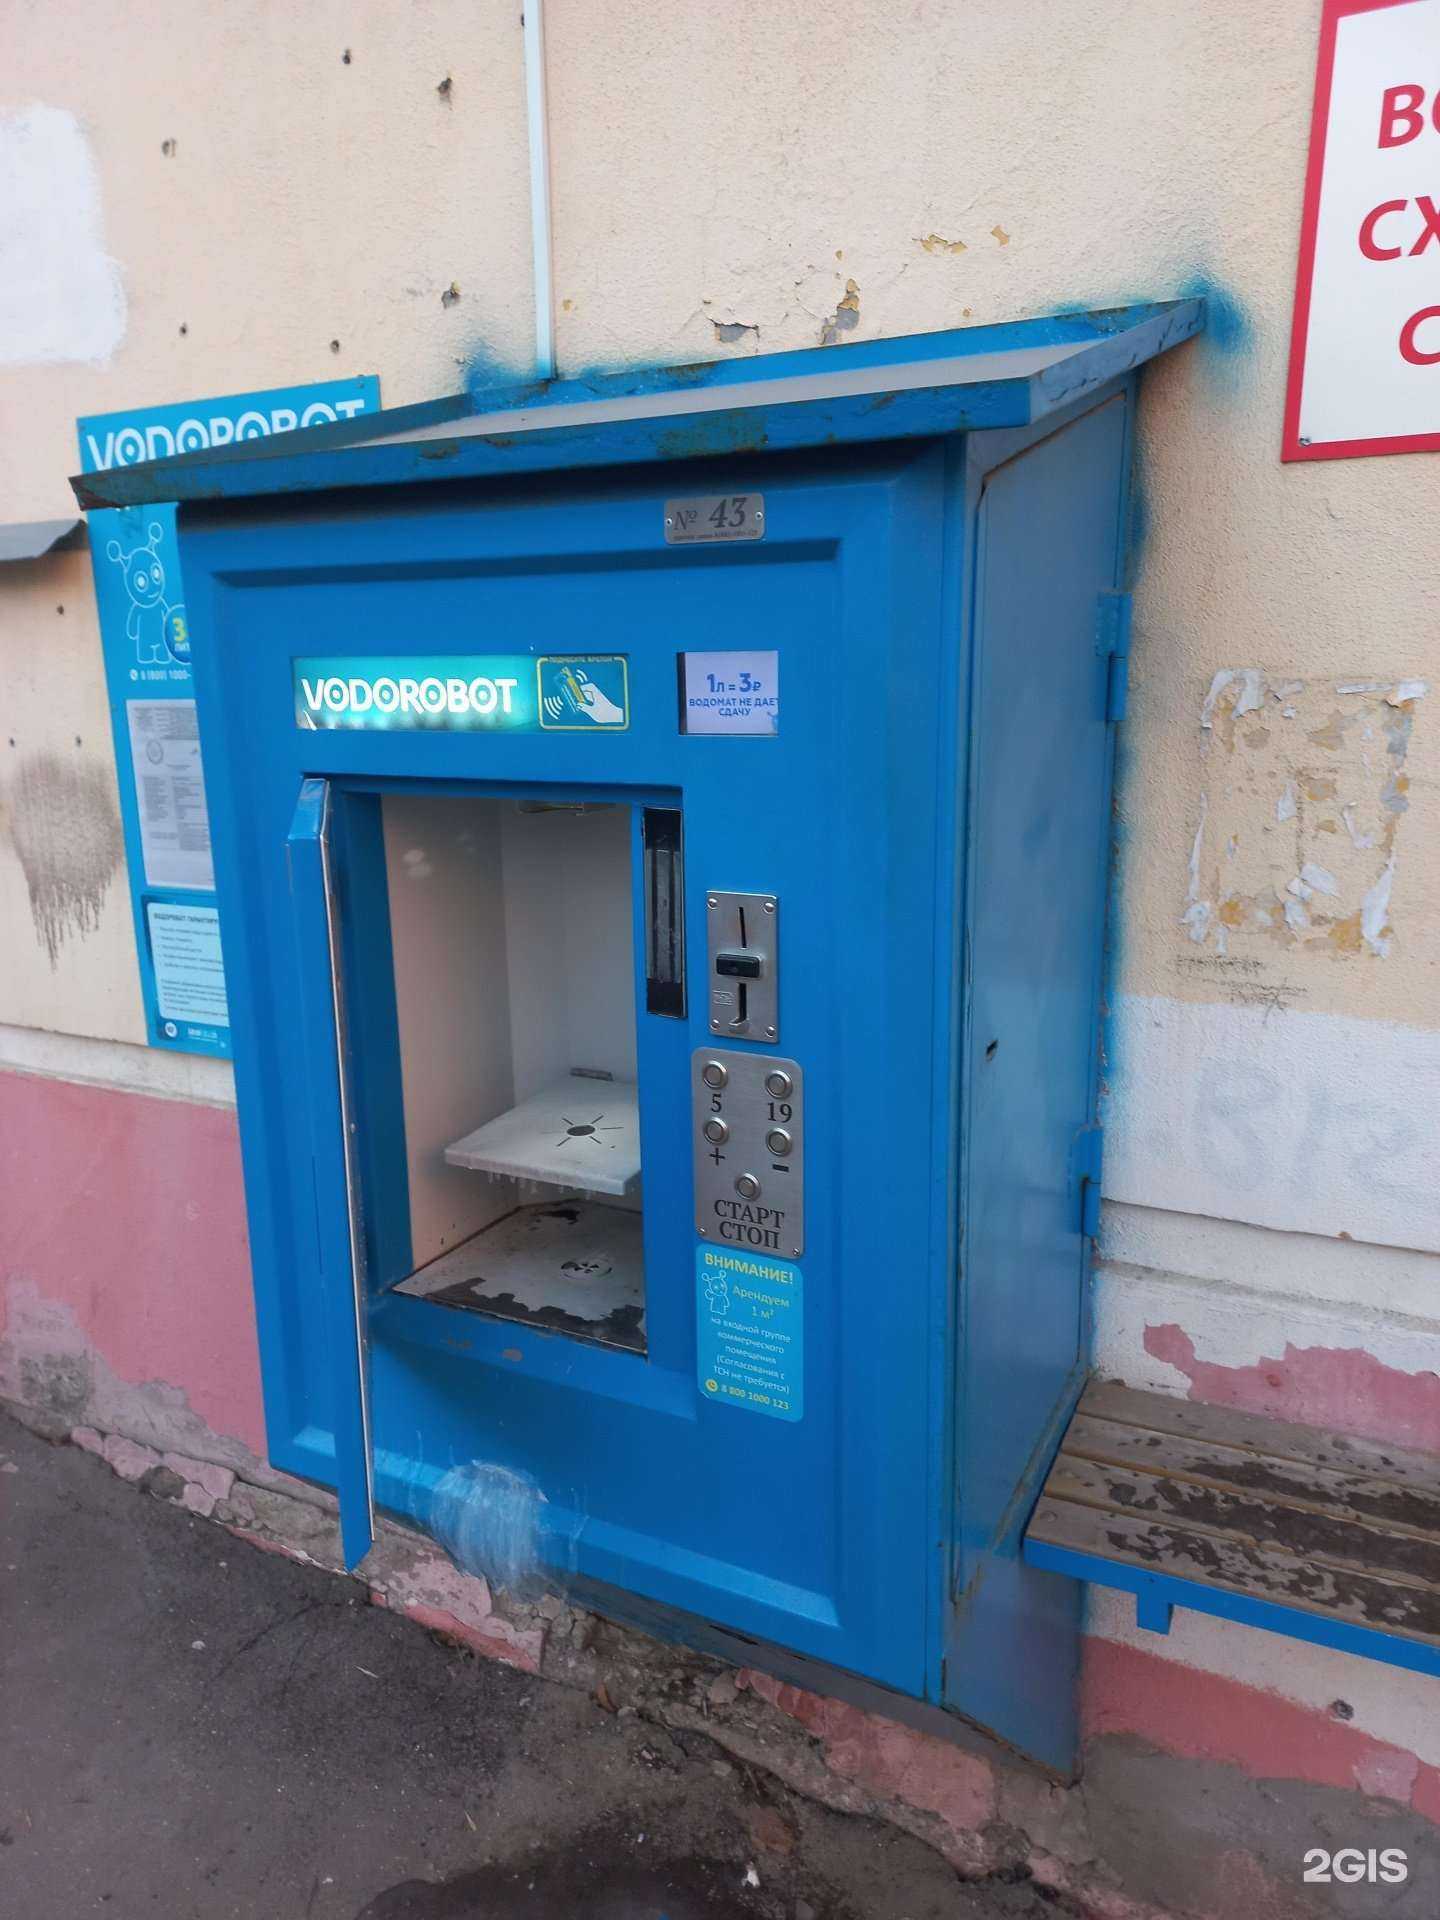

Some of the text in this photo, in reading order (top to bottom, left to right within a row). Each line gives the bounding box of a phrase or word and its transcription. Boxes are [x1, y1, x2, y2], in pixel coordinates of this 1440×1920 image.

[1378, 84, 1440, 148] В
[708, 496, 748, 528] 43
[301, 677, 518, 714] VODOROBOT
[689, 697, 736, 708] ВОДОМАТ
[740, 697, 752, 707] НЕ
[719, 707, 751, 716] СДАЧУ
[710, 1093, 793, 1124] 5 19
[713, 1199, 785, 1229] СТАРТ
[719, 1220, 781, 1250] СТОП
[704, 1253, 793, 1285] ВНИМАНИЕ!
[733, 1285, 789, 1308] Арендуем
[718, 1331, 784, 1354] коммерческого
[761, 1329, 791, 1344] группе
[725, 1345, 776, 1364] помещения
